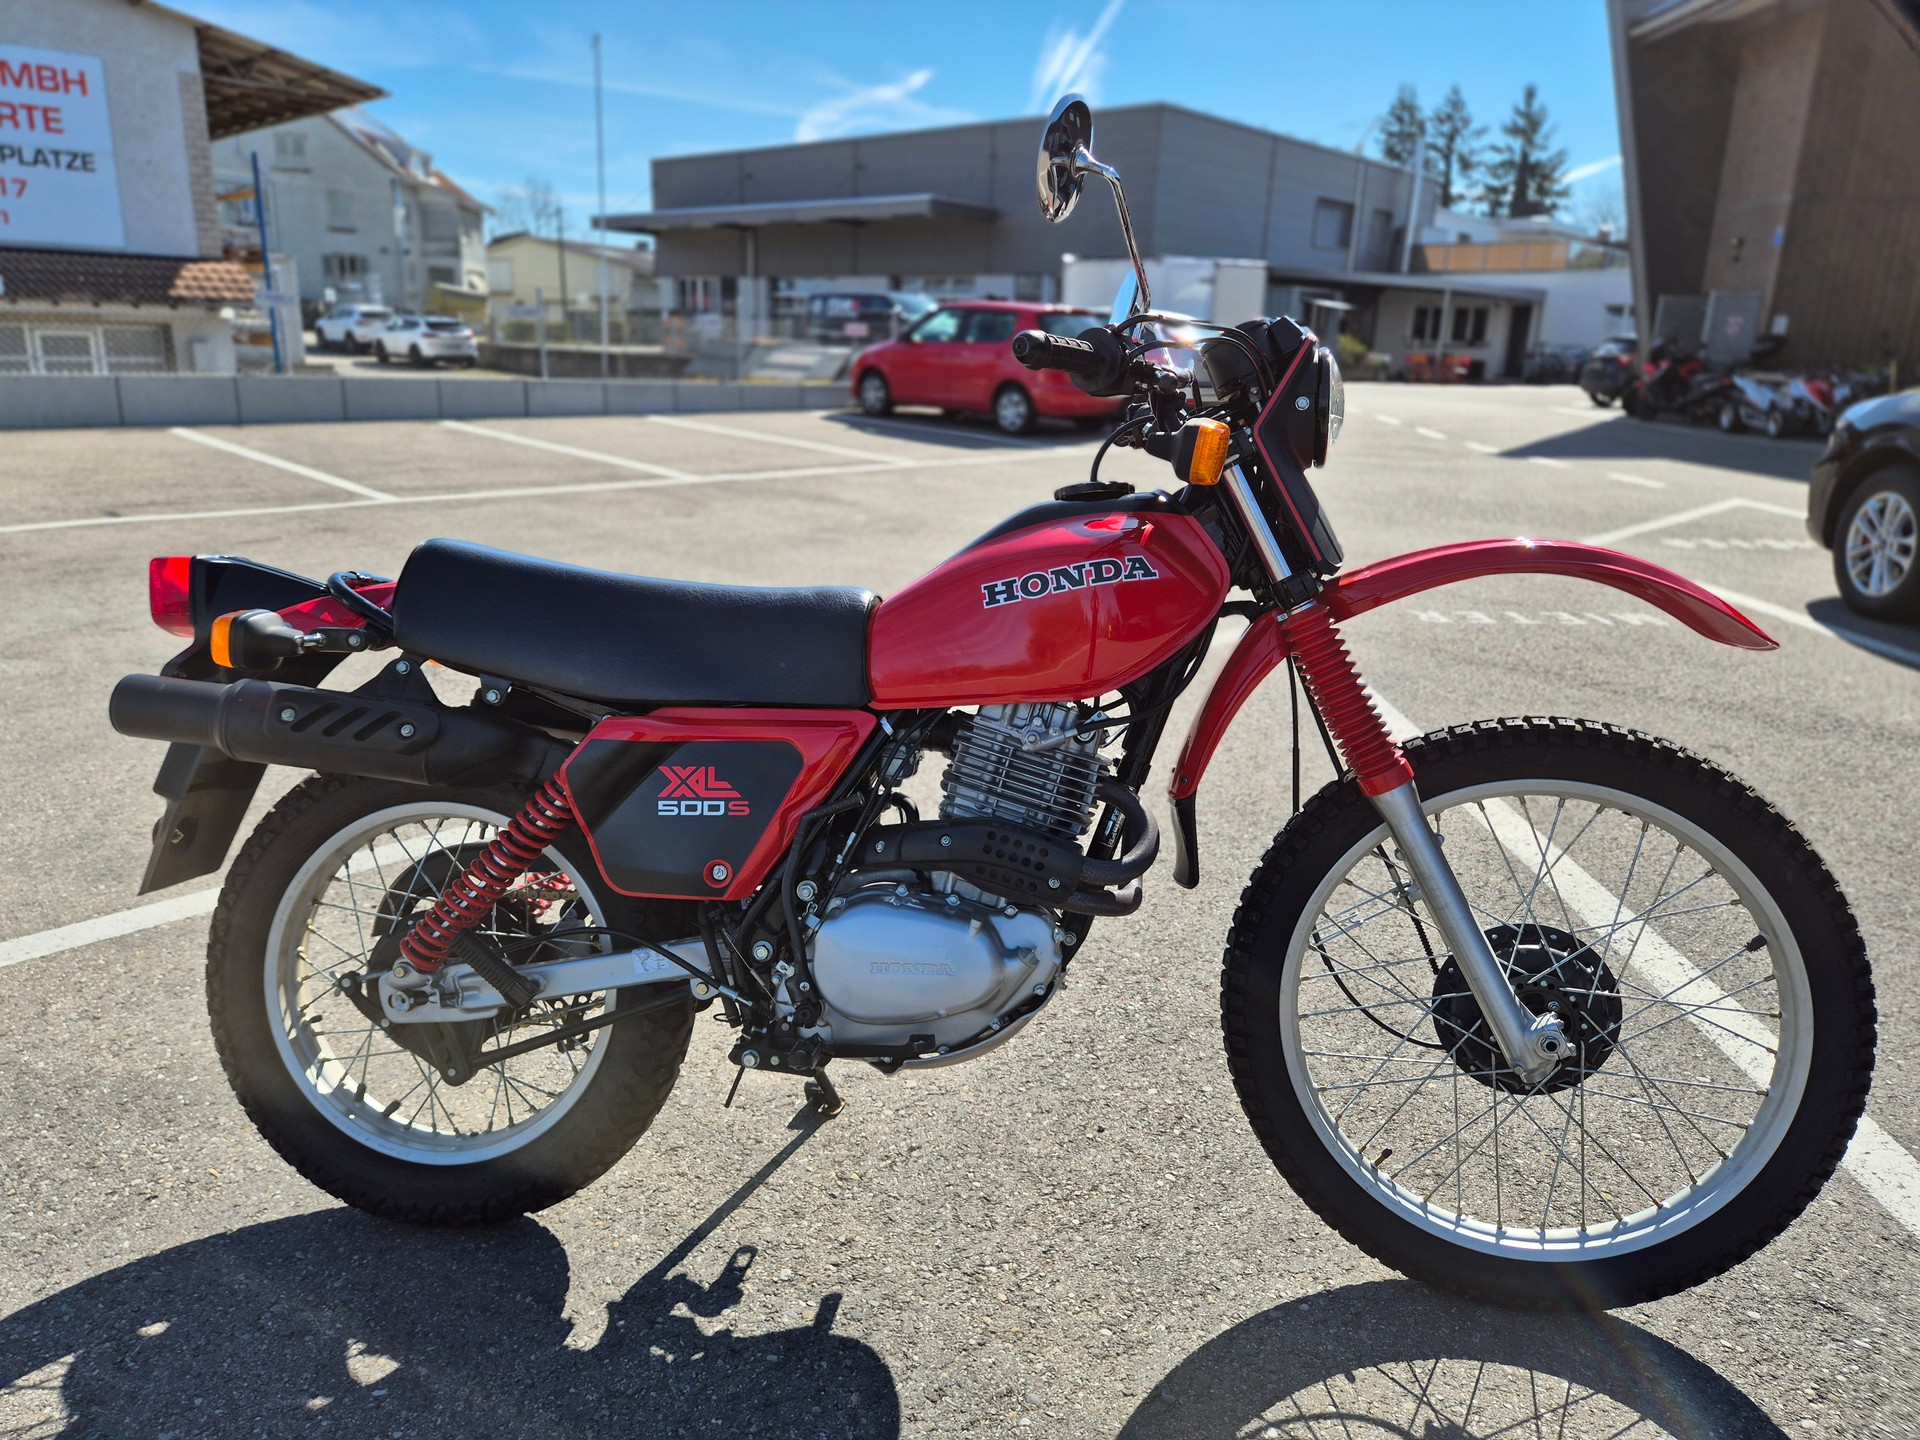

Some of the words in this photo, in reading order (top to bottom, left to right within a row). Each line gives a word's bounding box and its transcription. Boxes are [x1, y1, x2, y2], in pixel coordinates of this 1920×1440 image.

[981, 555, 1159, 609] HONDA
[657, 765, 742, 798] XL
[870, 961, 956, 976] HONDA
